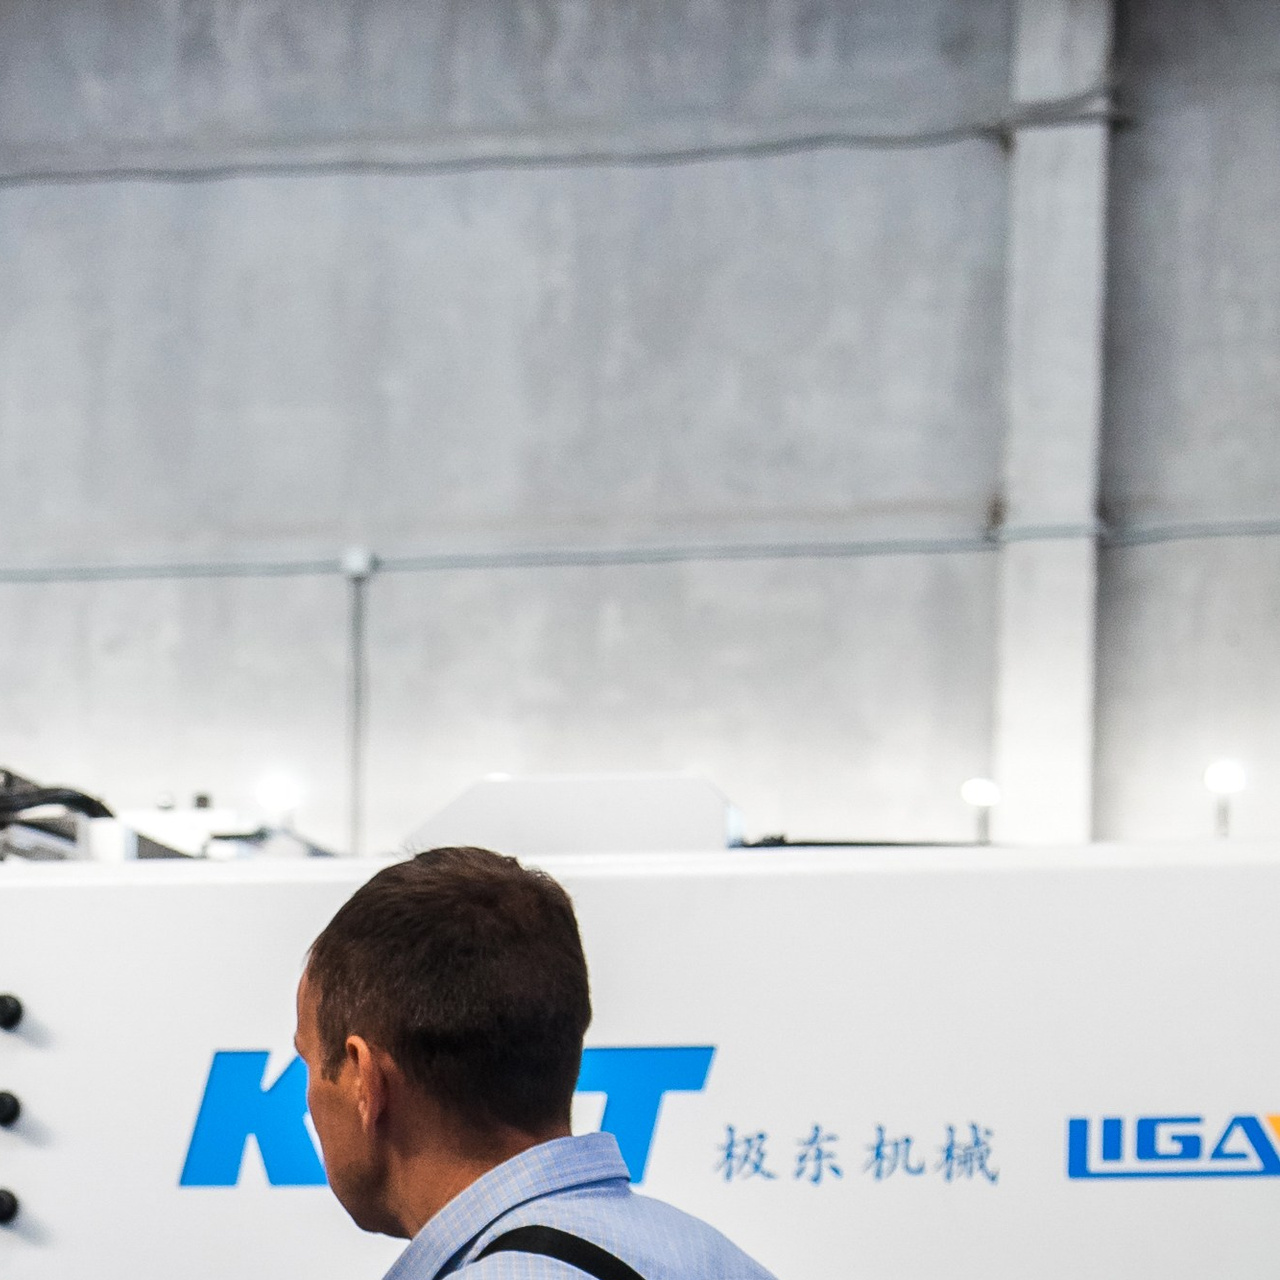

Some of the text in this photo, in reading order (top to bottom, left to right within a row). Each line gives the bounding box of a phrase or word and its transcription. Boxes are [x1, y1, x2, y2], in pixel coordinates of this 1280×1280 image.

[179, 1045, 716, 1188] KT
[716, 1122, 1000, 1186] 极东机械
